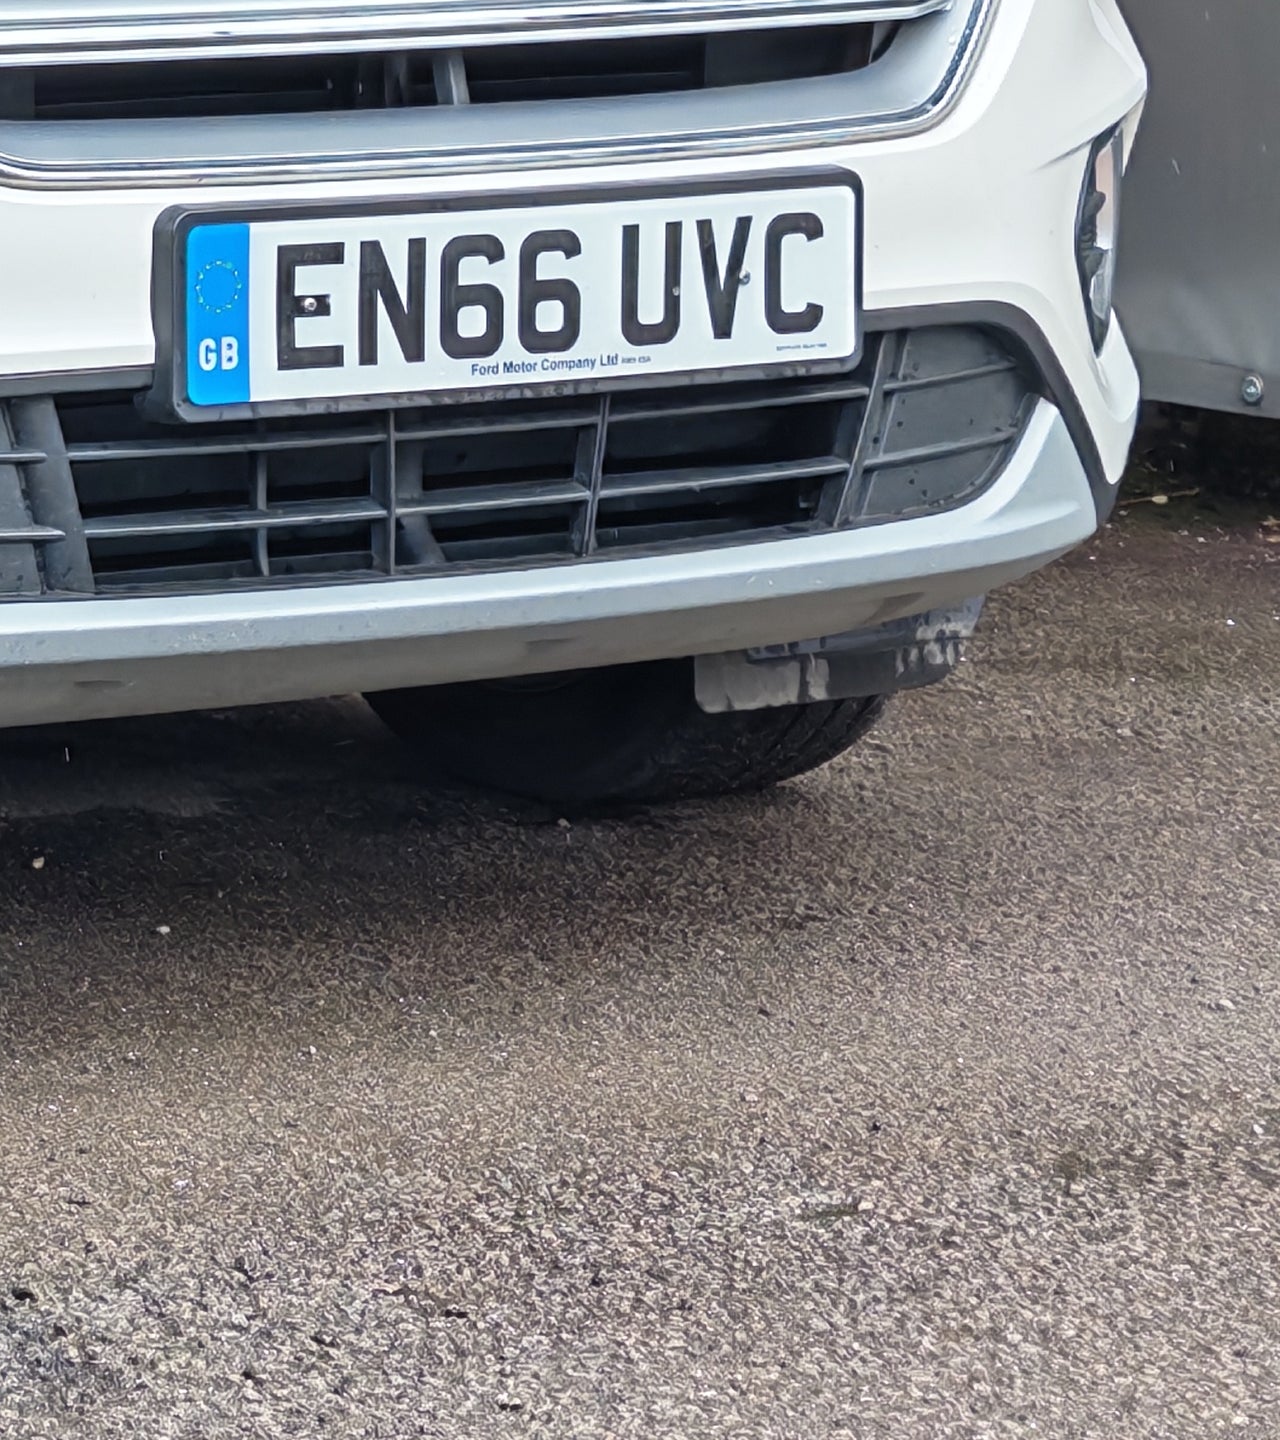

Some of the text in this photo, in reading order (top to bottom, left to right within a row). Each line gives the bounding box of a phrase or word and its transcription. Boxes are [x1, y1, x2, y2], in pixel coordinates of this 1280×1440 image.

[276, 212, 824, 371] EN66 UVC
[198, 338, 239, 372] GB
[471, 362, 499, 376] Ford
[502, 359, 538, 374] Motor
[541, 356, 597, 372] Company
[600, 353, 618, 366] Ltd
